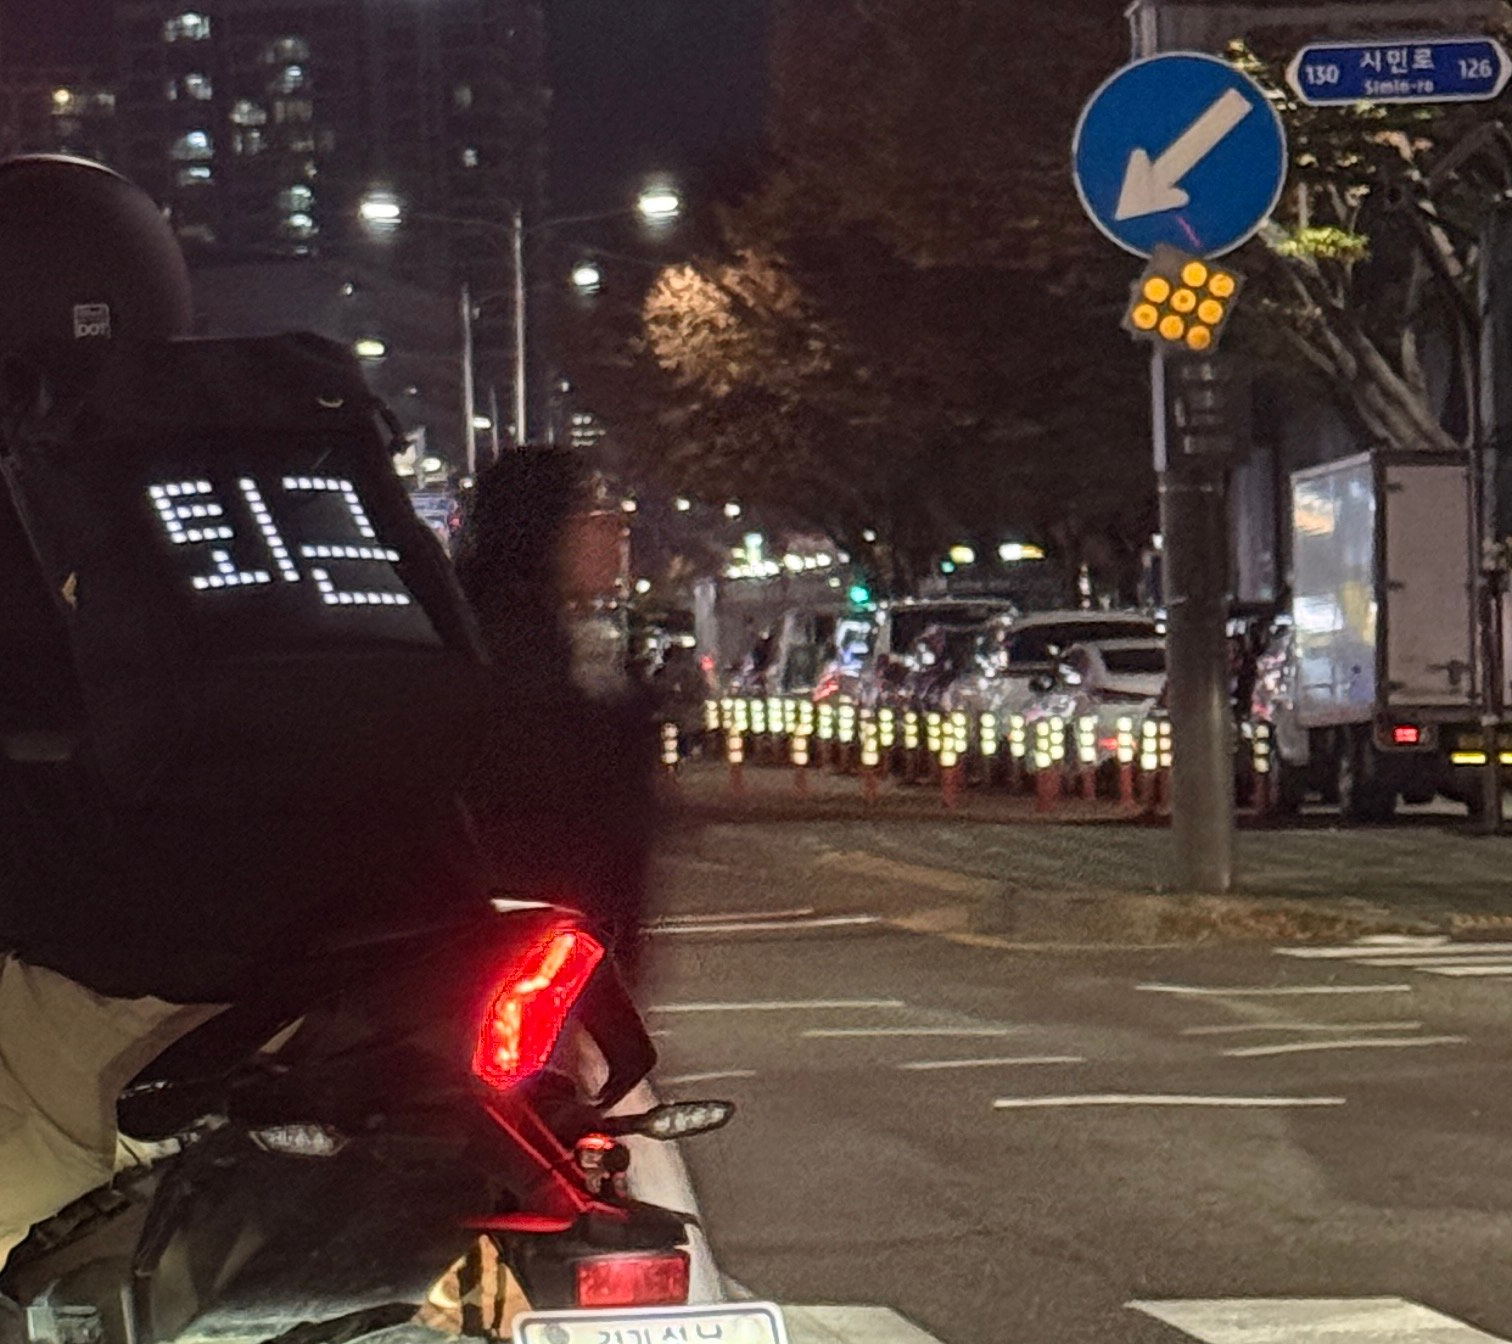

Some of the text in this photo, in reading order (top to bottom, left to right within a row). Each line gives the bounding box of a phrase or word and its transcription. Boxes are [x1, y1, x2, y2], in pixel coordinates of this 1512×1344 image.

[1359, 46, 1436, 75] 시민로
[1458, 57, 1493, 80] 126
[1304, 63, 1340, 86] 130
[1363, 78, 1435, 96] Simin-ro
[147, 476, 411, 606] 퇴근
